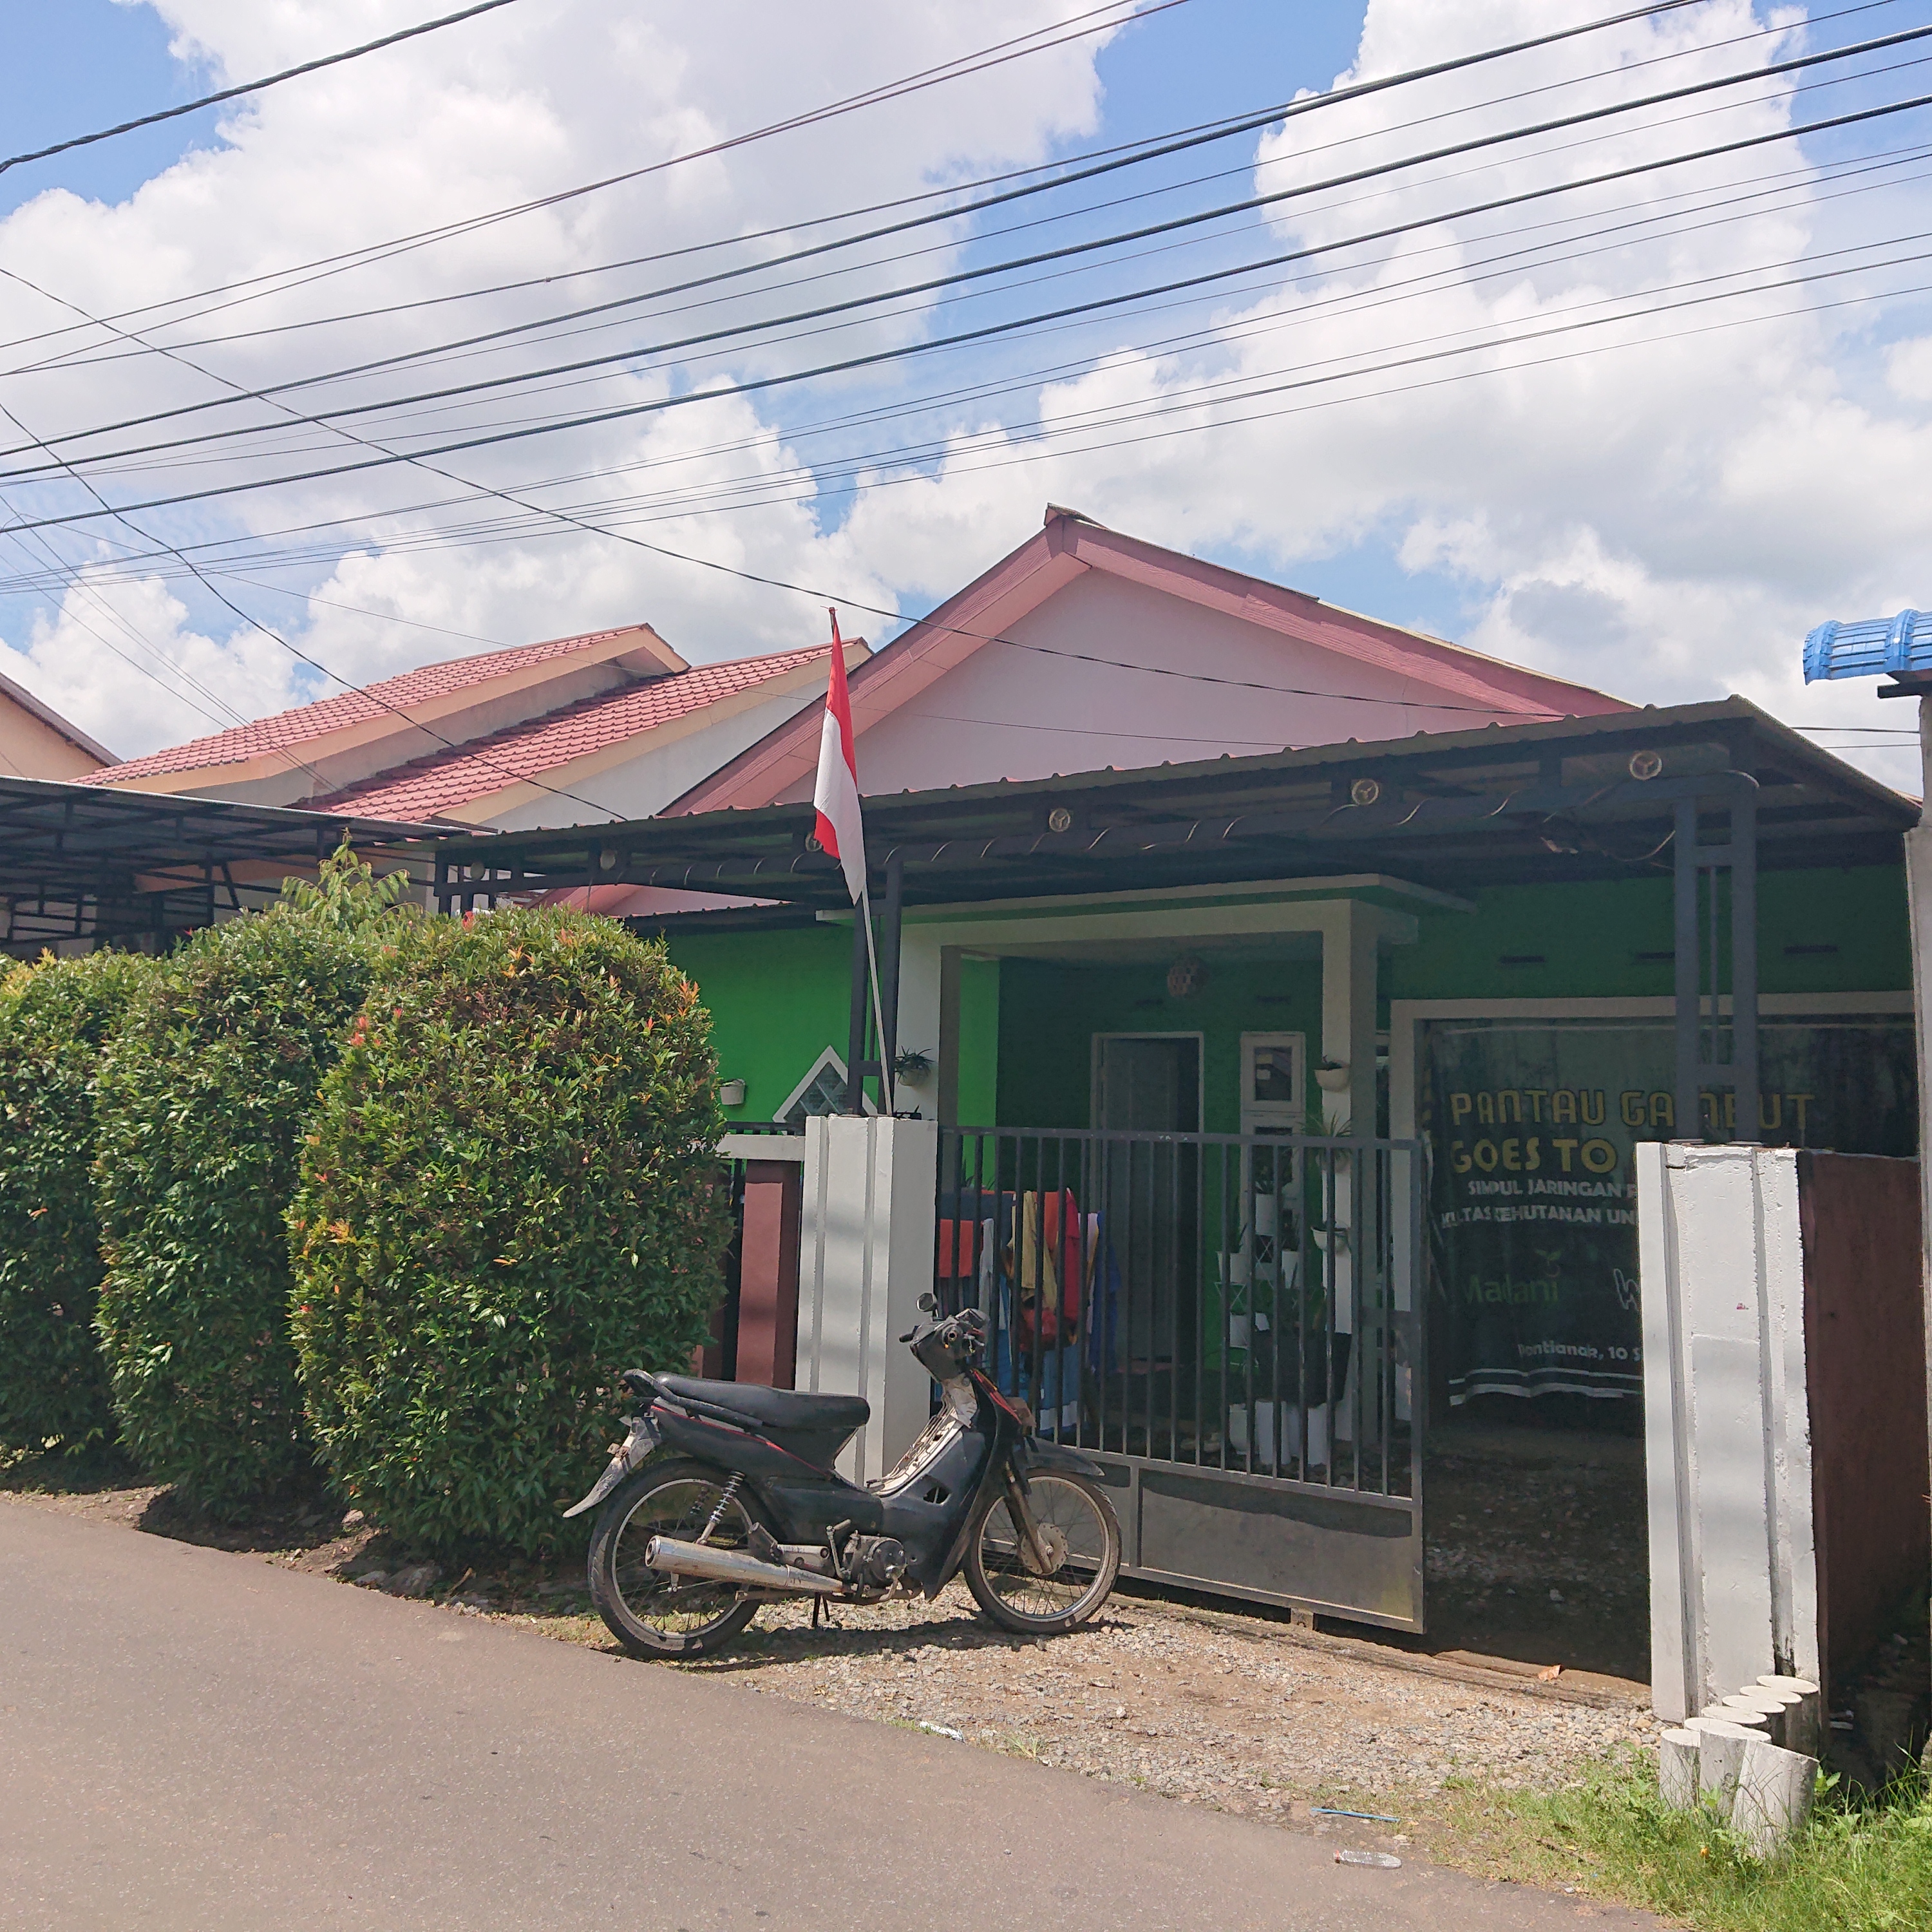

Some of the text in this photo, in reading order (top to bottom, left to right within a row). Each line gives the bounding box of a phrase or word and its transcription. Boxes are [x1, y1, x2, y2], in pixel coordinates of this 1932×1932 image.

[1450, 1089, 1605, 1126] PANTAU
[1450, 1137, 1617, 1173] GOES TO
[1528, 1179, 1622, 1198] JARINGAN
[1607, 1347, 1629, 1361] 10
